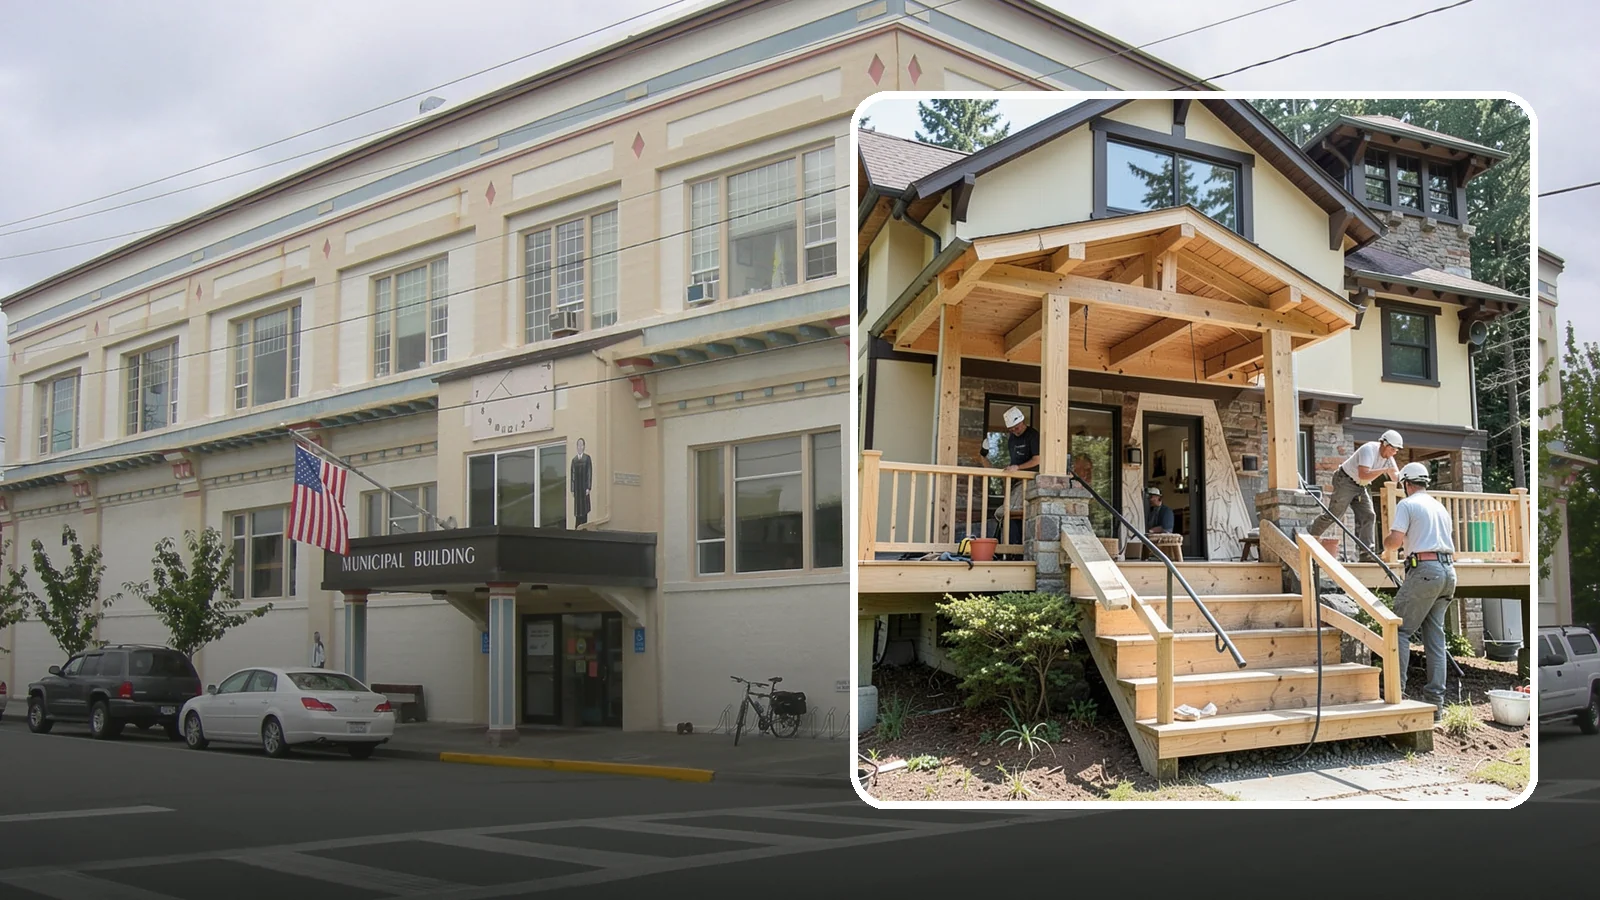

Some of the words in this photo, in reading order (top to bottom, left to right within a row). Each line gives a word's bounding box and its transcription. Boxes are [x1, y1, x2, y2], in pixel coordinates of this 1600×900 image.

[507, 425, 513, 433] 12
[342, 552, 405, 572] MUNICIPAL
[414, 546, 475, 567] BUILDING
